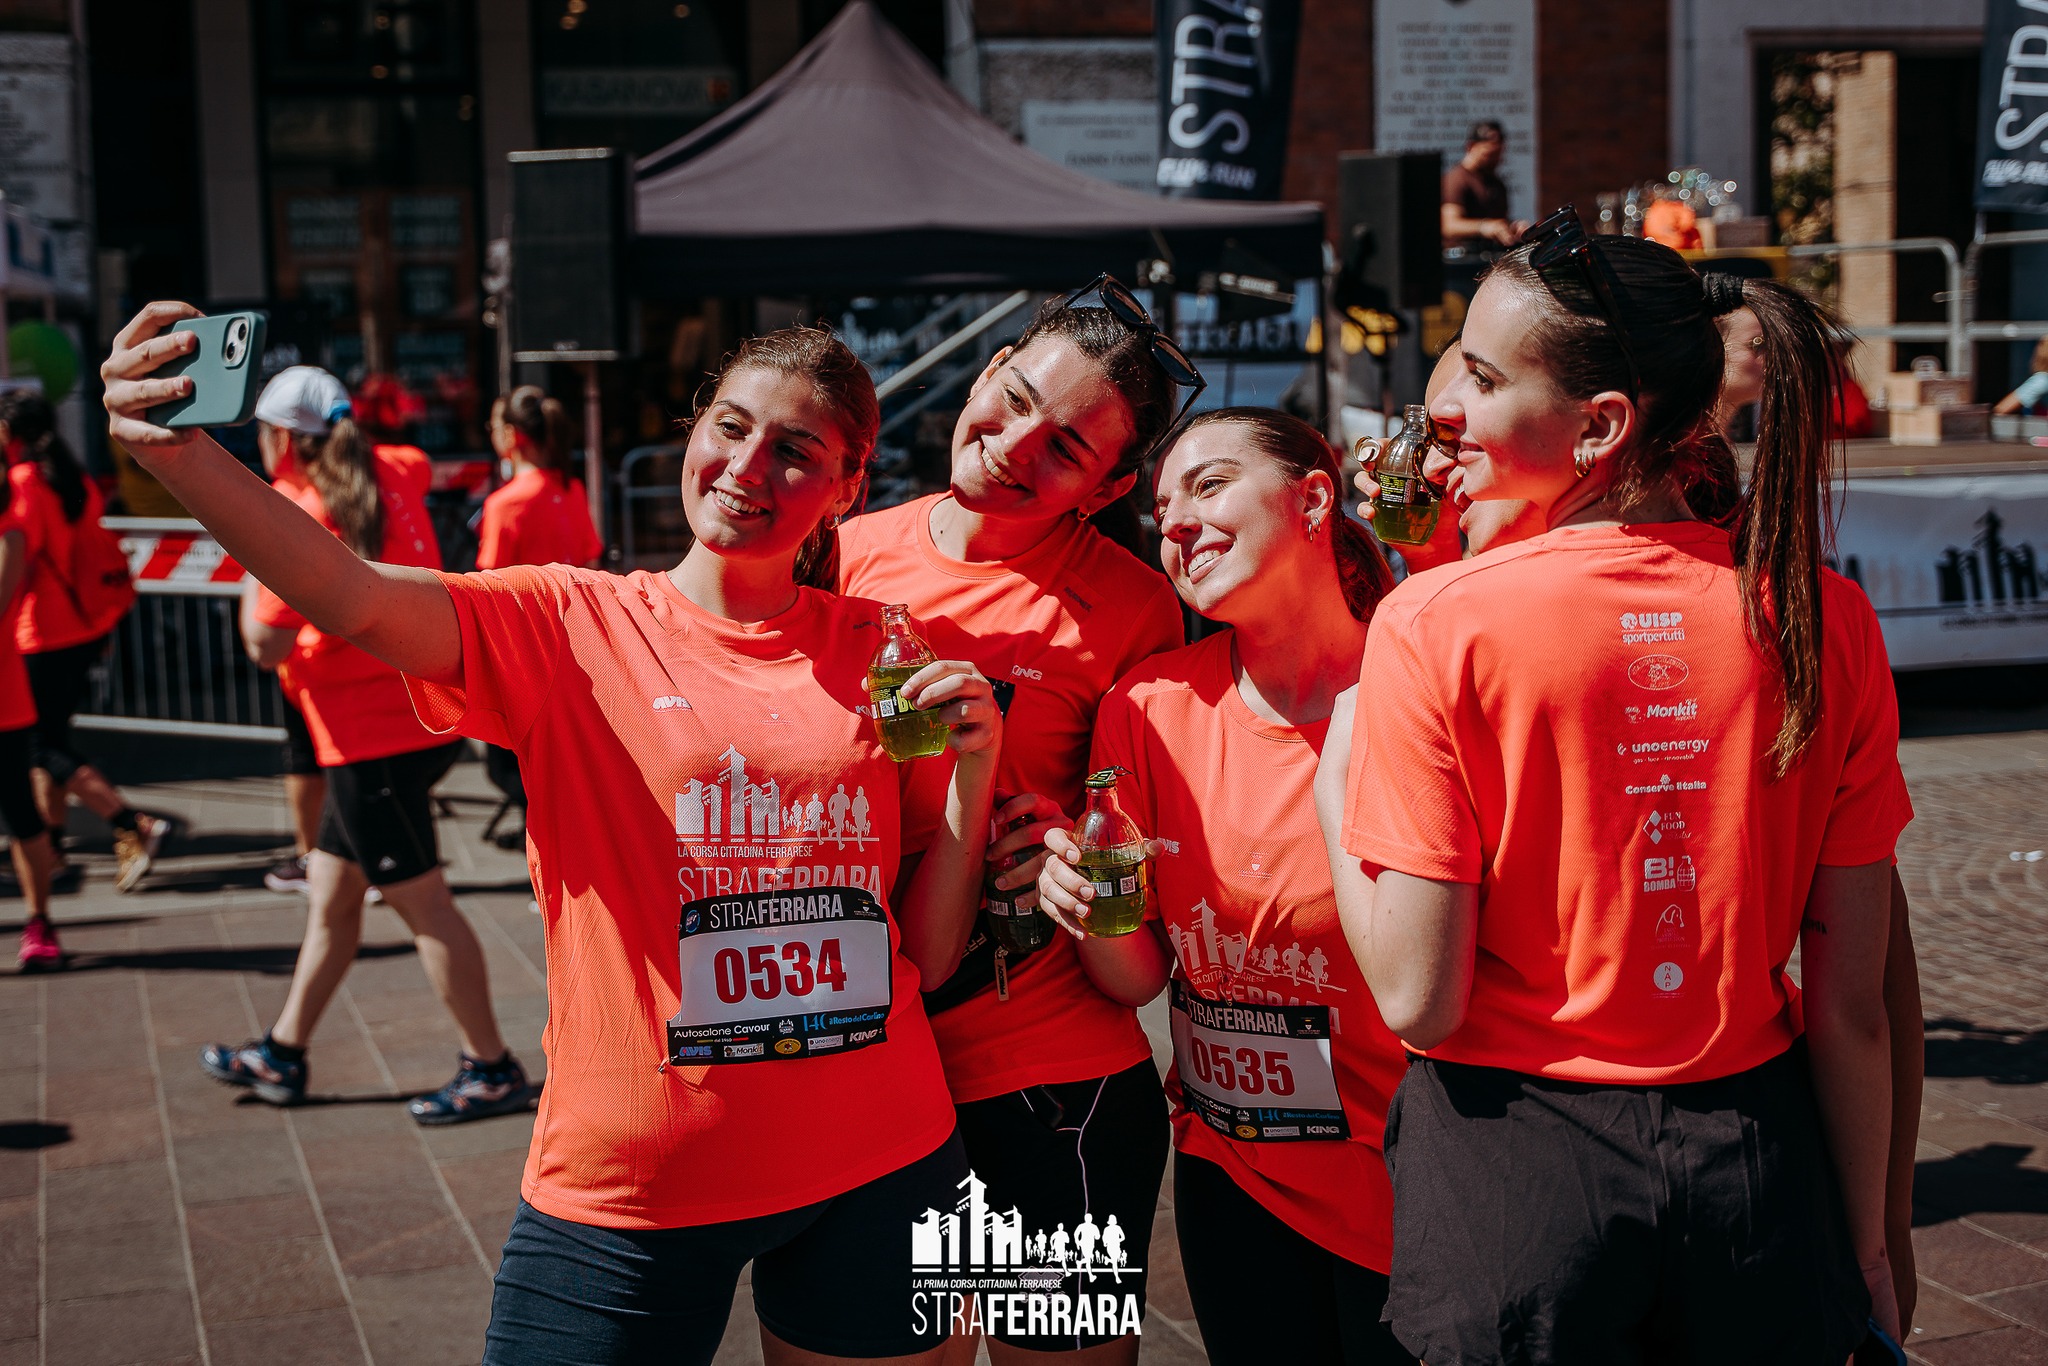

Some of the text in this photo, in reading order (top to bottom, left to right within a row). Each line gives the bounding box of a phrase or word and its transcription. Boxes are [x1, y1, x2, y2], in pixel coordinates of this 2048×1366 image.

[1622, 629, 1685, 645] sportpertutti
[1646, 701, 1698, 719] Monkit
[1632, 738, 1710, 753] unoenergy
[1625, 780, 1707, 795] Conserve Italia
[1664, 811, 1682, 821] FUN
[1661, 820, 1686, 831] FOOD
[677, 845, 813, 858] LA CORSA CITTADINA FERRARESE
[1644, 856, 1675, 880] B!
[1643, 878, 1676, 893] BOMBA
[709, 893, 845, 929] STRAFERRARA
[713, 938, 848, 1005] 0534
[861, 1011, 885, 1021] Carlino
[1187, 997, 1289, 1036] STRAFERRARA
[674, 1027, 731, 1038] Autosalone
[733, 1023, 770, 1034] Cavour
[679, 1045, 713, 1056] AVIS
[736, 1044, 763, 1055] Monkit
[849, 1028, 878, 1042] KING
[1191, 1036, 1296, 1097] 0535
[1306, 1125, 1340, 1134] KING
